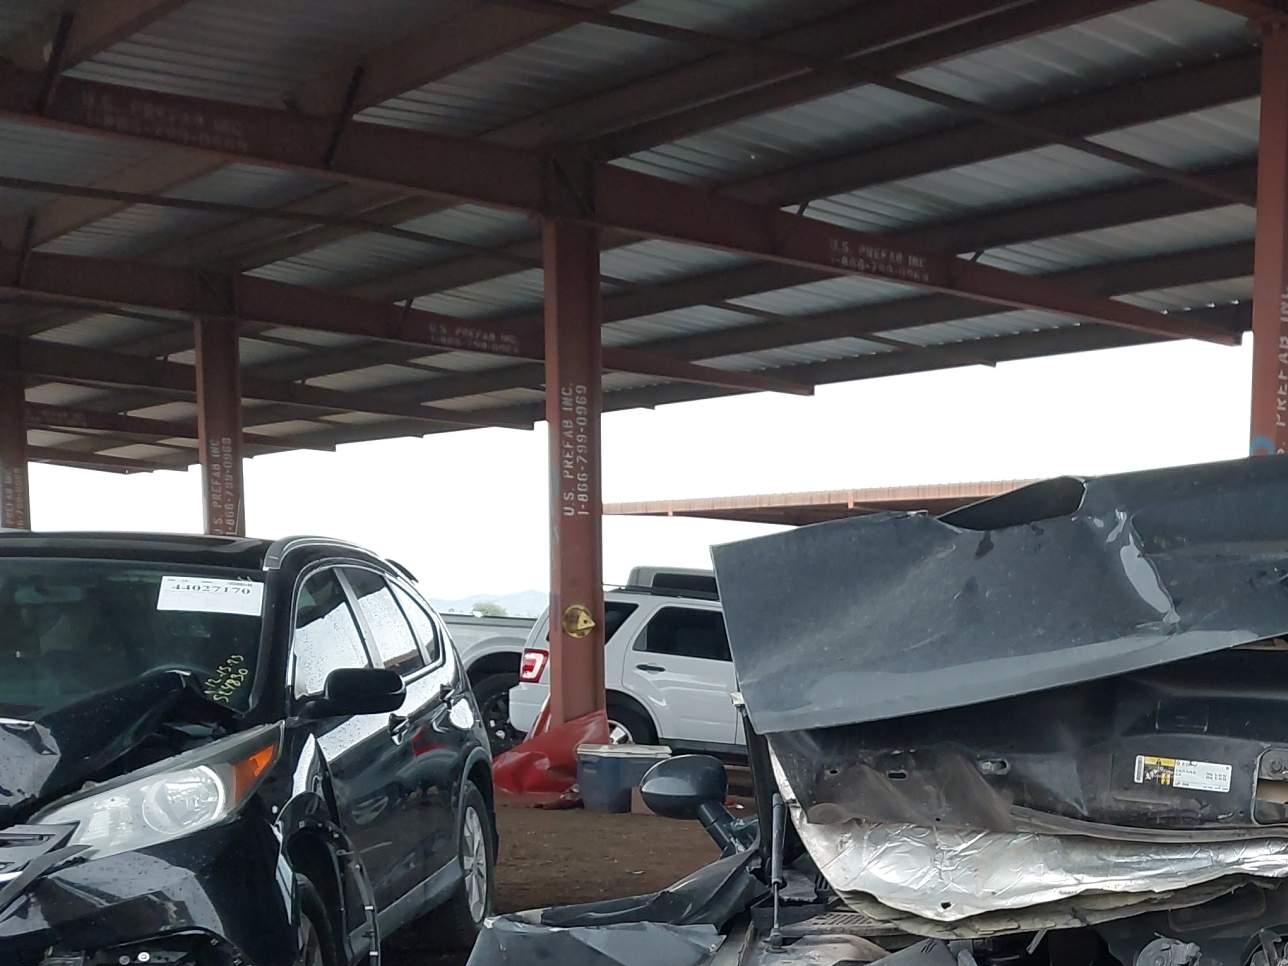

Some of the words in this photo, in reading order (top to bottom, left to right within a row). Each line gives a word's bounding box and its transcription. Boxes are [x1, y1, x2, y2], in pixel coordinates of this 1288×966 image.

[562, 419, 575, 479] PREFAB
[575, 384, 590, 516] 1-866-799-0969
[211, 463, 222, 508] PREFAB
[171, 583, 251, 595] 44027170
